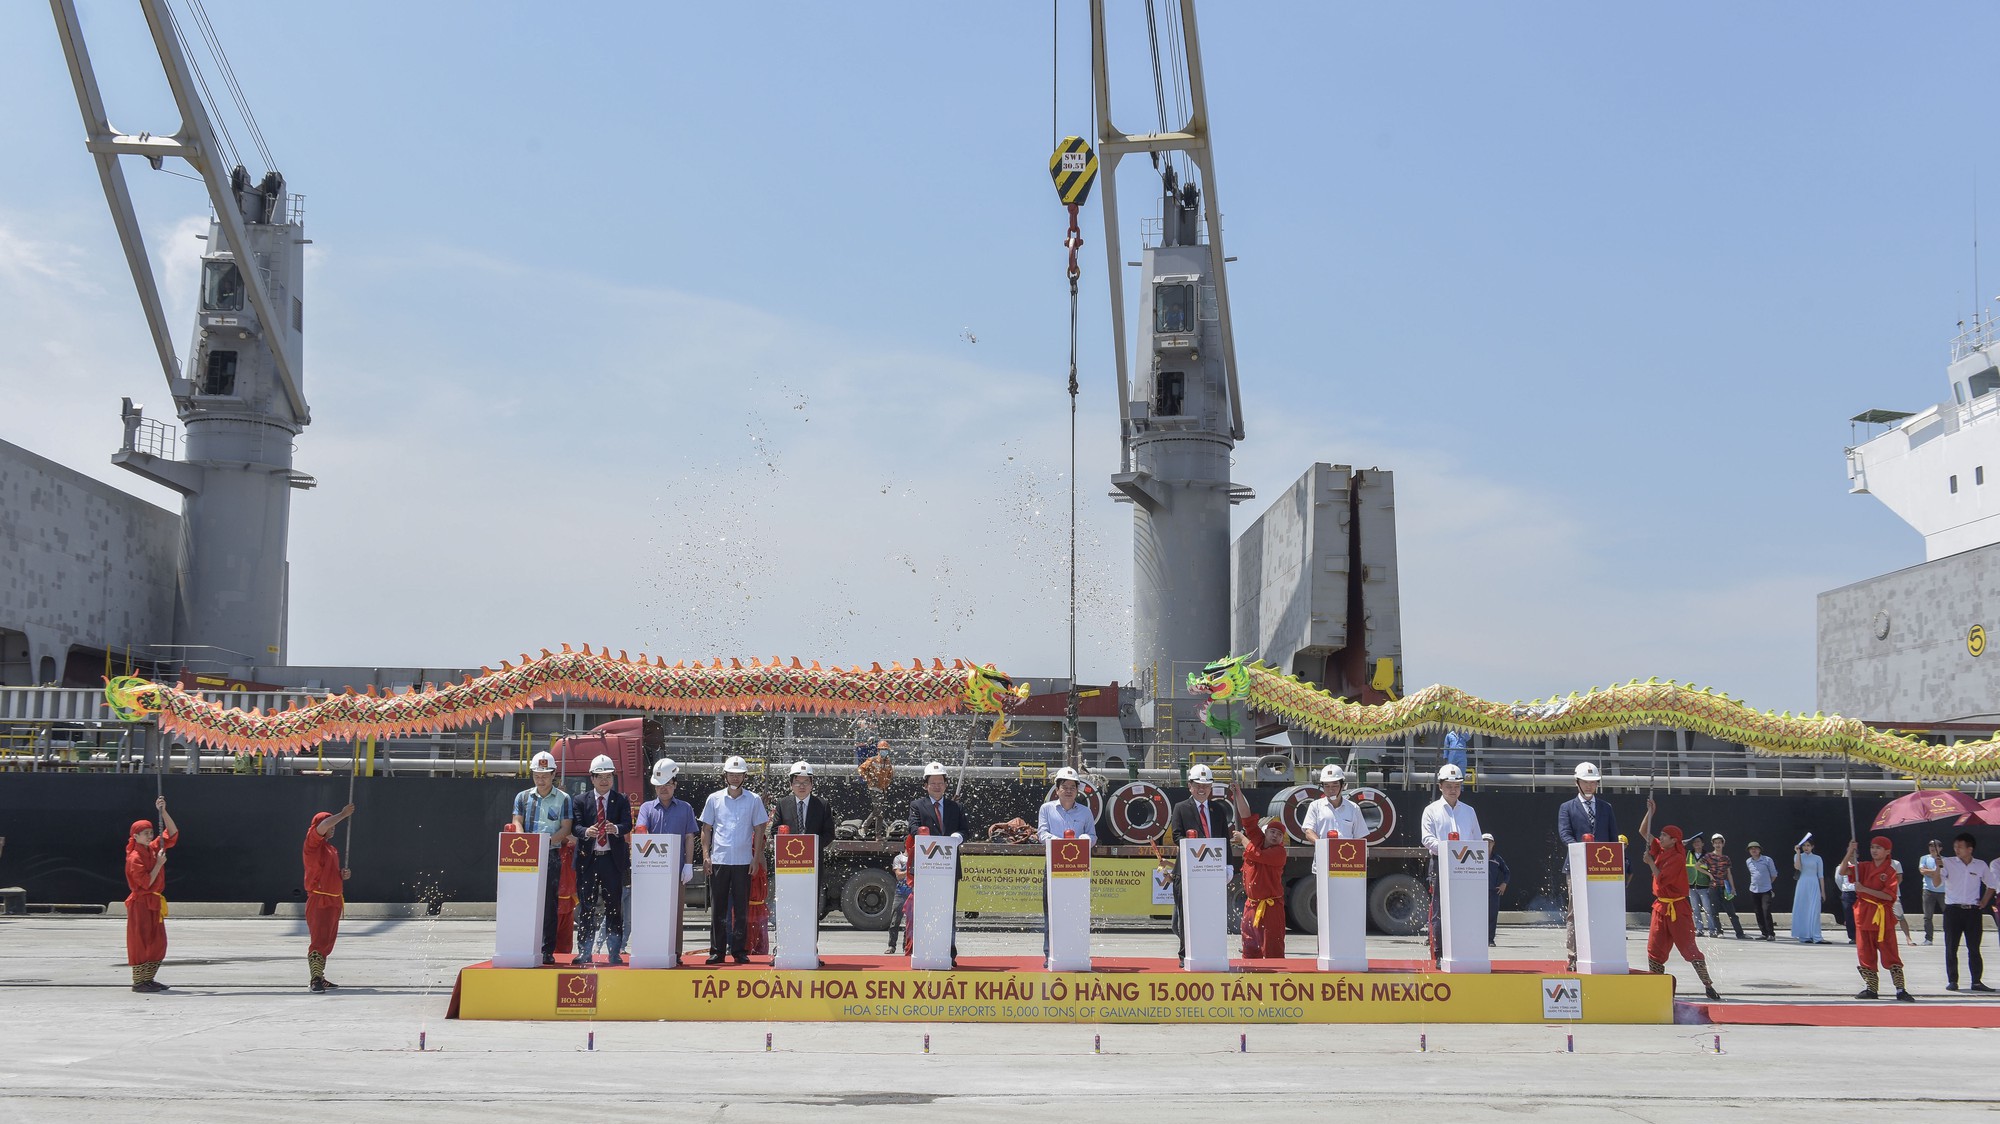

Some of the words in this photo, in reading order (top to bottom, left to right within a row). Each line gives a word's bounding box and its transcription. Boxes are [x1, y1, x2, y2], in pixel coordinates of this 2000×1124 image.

[1970, 628, 1983, 652] 5
[635, 839, 668, 857] VAS
[920, 841, 953, 859] VAS
[1190, 844, 1223, 862] VAS
[1452, 846, 1485, 864] VAS
[692, 974, 730, 1003] TẬP
[737, 975, 802, 999] ĐOÀN
[811, 980, 858, 999] HOA
[865, 980, 905, 999] SEN
[912, 975, 968, 1000] XUẤT
[975, 975, 1034, 1000] KHẨU
[1042, 977, 1068, 1001] LÔ
[1075, 978, 1139, 1001] HÀNG
[1149, 982, 1214, 1001] 15.000
[1221, 976, 1263, 1001] TẤN
[1269, 978, 1314, 1001] TÔN
[1321, 976, 1363, 1001] ĐẾN
[1371, 983, 1451, 1002] MEXICO
[1545, 984, 1578, 1003] VAS
[844, 1005, 871, 1016] HOA
[875, 1005, 898, 1016] SEN
[903, 1005, 944, 1016] GROUP
[949, 1006, 996, 1017] EXPORTS
[1002, 1006, 1039, 1018] 15,000
[1043, 1006, 1075, 1017] TONS
[1079, 1007, 1095, 1017] OF
[1100, 1007, 1171, 1017] GALVANIZED
[1175, 1007, 1204, 1017] STEEL
[1208, 1007, 1235, 1018] COIL
[1239, 1007, 1254, 1018] TO
[1258, 1007, 1303, 1018] MEXICO
